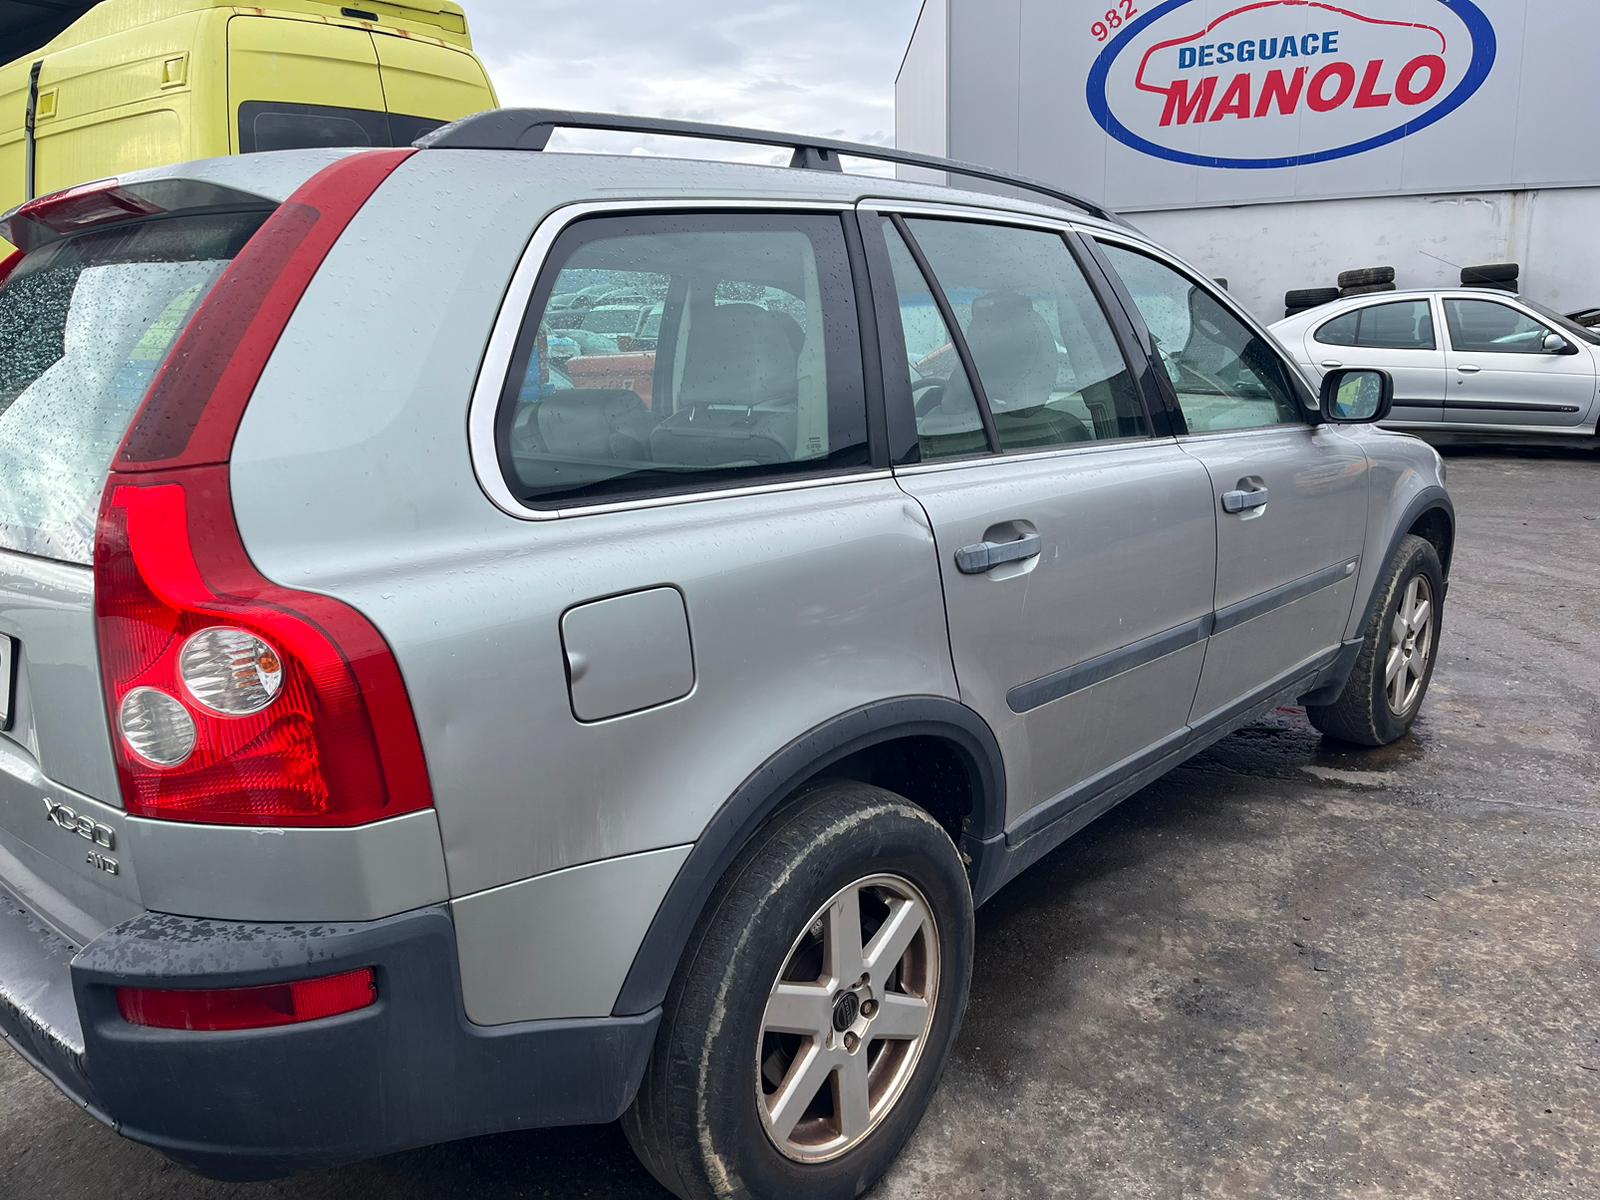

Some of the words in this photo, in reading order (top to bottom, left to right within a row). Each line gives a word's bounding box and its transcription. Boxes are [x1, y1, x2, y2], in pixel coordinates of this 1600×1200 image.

[1091, 0, 1137, 41] 982
[1178, 31, 1339, 69] DESGUACE
[1159, 54, 1446, 127] MANOLO
[43, 797, 115, 850] XC90
